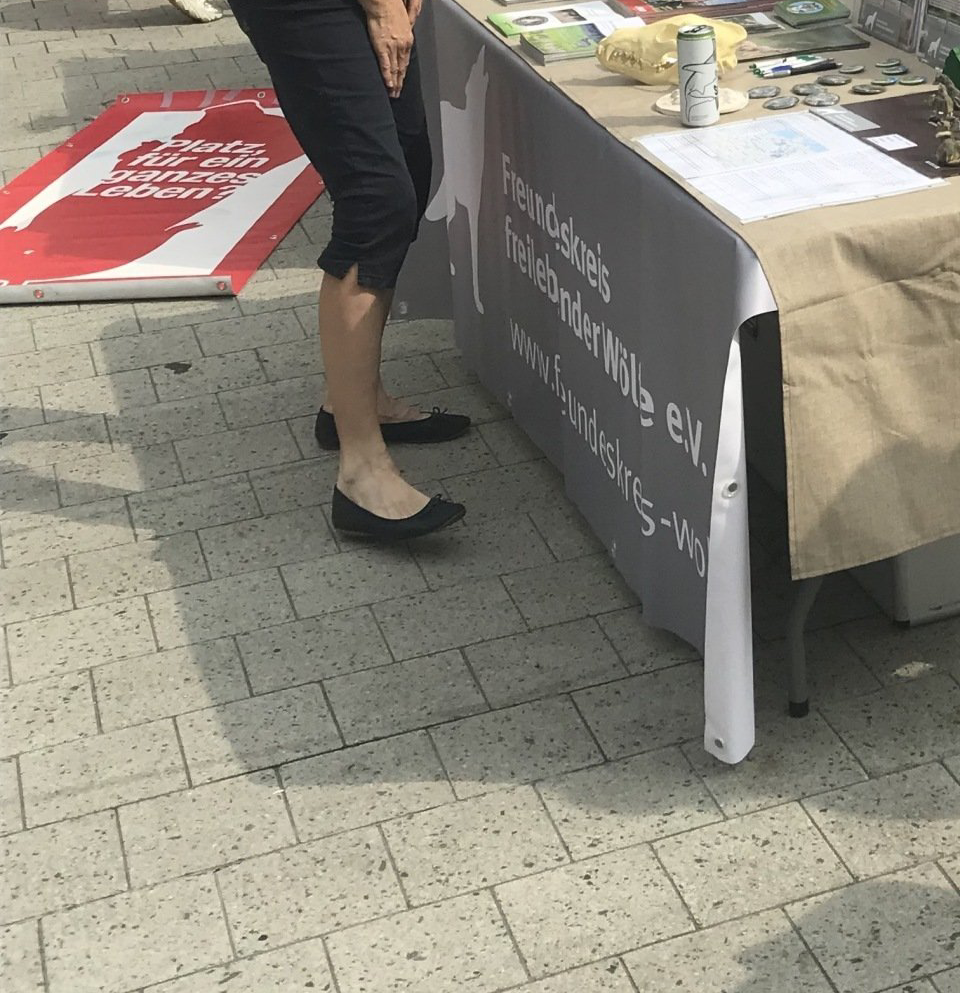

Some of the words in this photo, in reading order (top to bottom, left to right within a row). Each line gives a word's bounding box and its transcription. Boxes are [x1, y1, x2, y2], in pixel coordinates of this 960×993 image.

[151, 138, 267, 157] Platz,
[126, 152, 200, 168] für
[199, 153, 270, 169] ein
[100, 169, 264, 186] ganzes
[666, 401, 707, 477] e.V.
